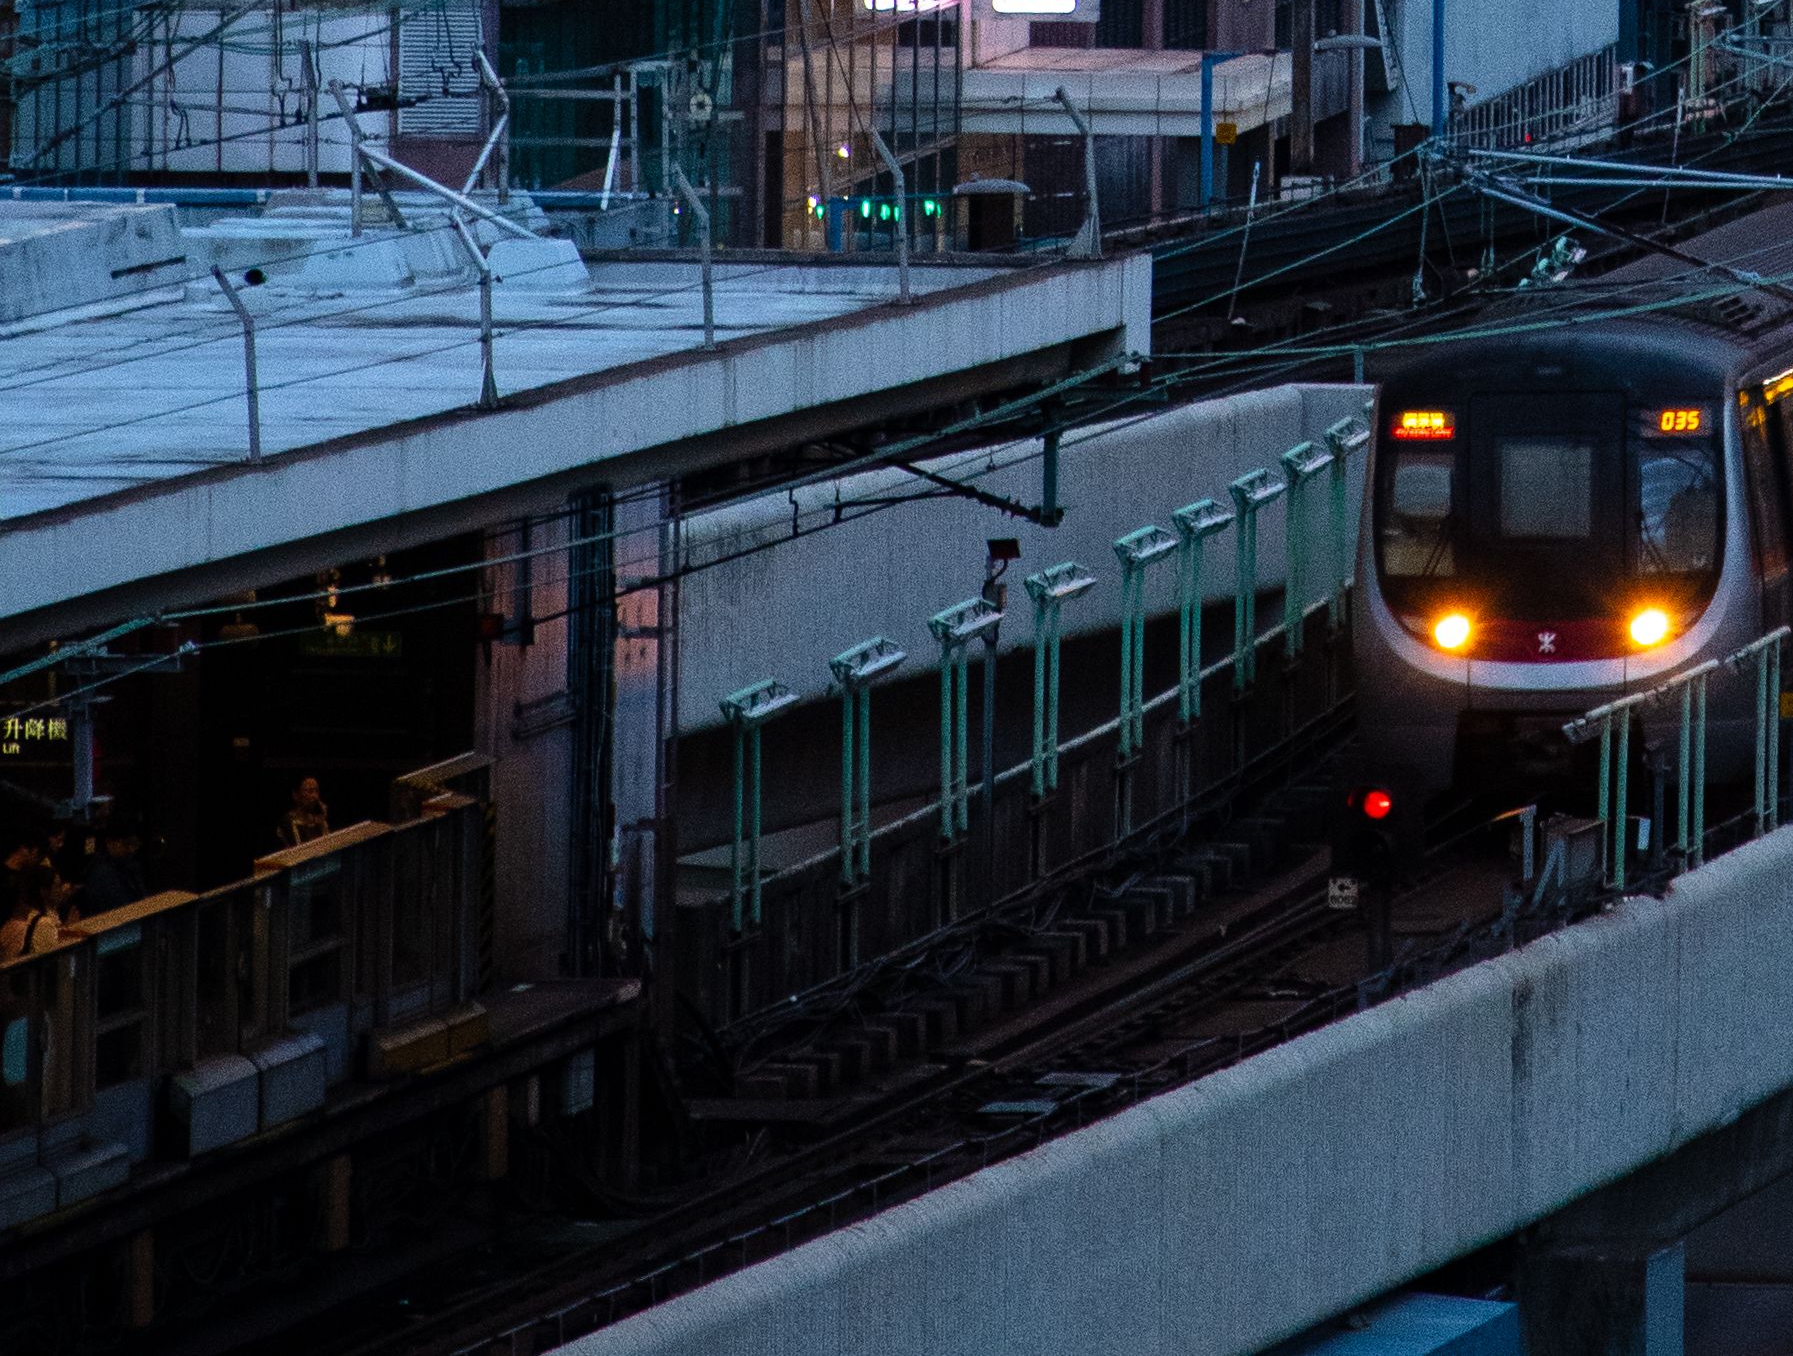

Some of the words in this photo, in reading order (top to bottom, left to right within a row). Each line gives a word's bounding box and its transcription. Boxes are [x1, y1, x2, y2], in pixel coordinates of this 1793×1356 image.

[1661, 410, 1700, 430] 035
[3, 717, 68, 741] 升降機
